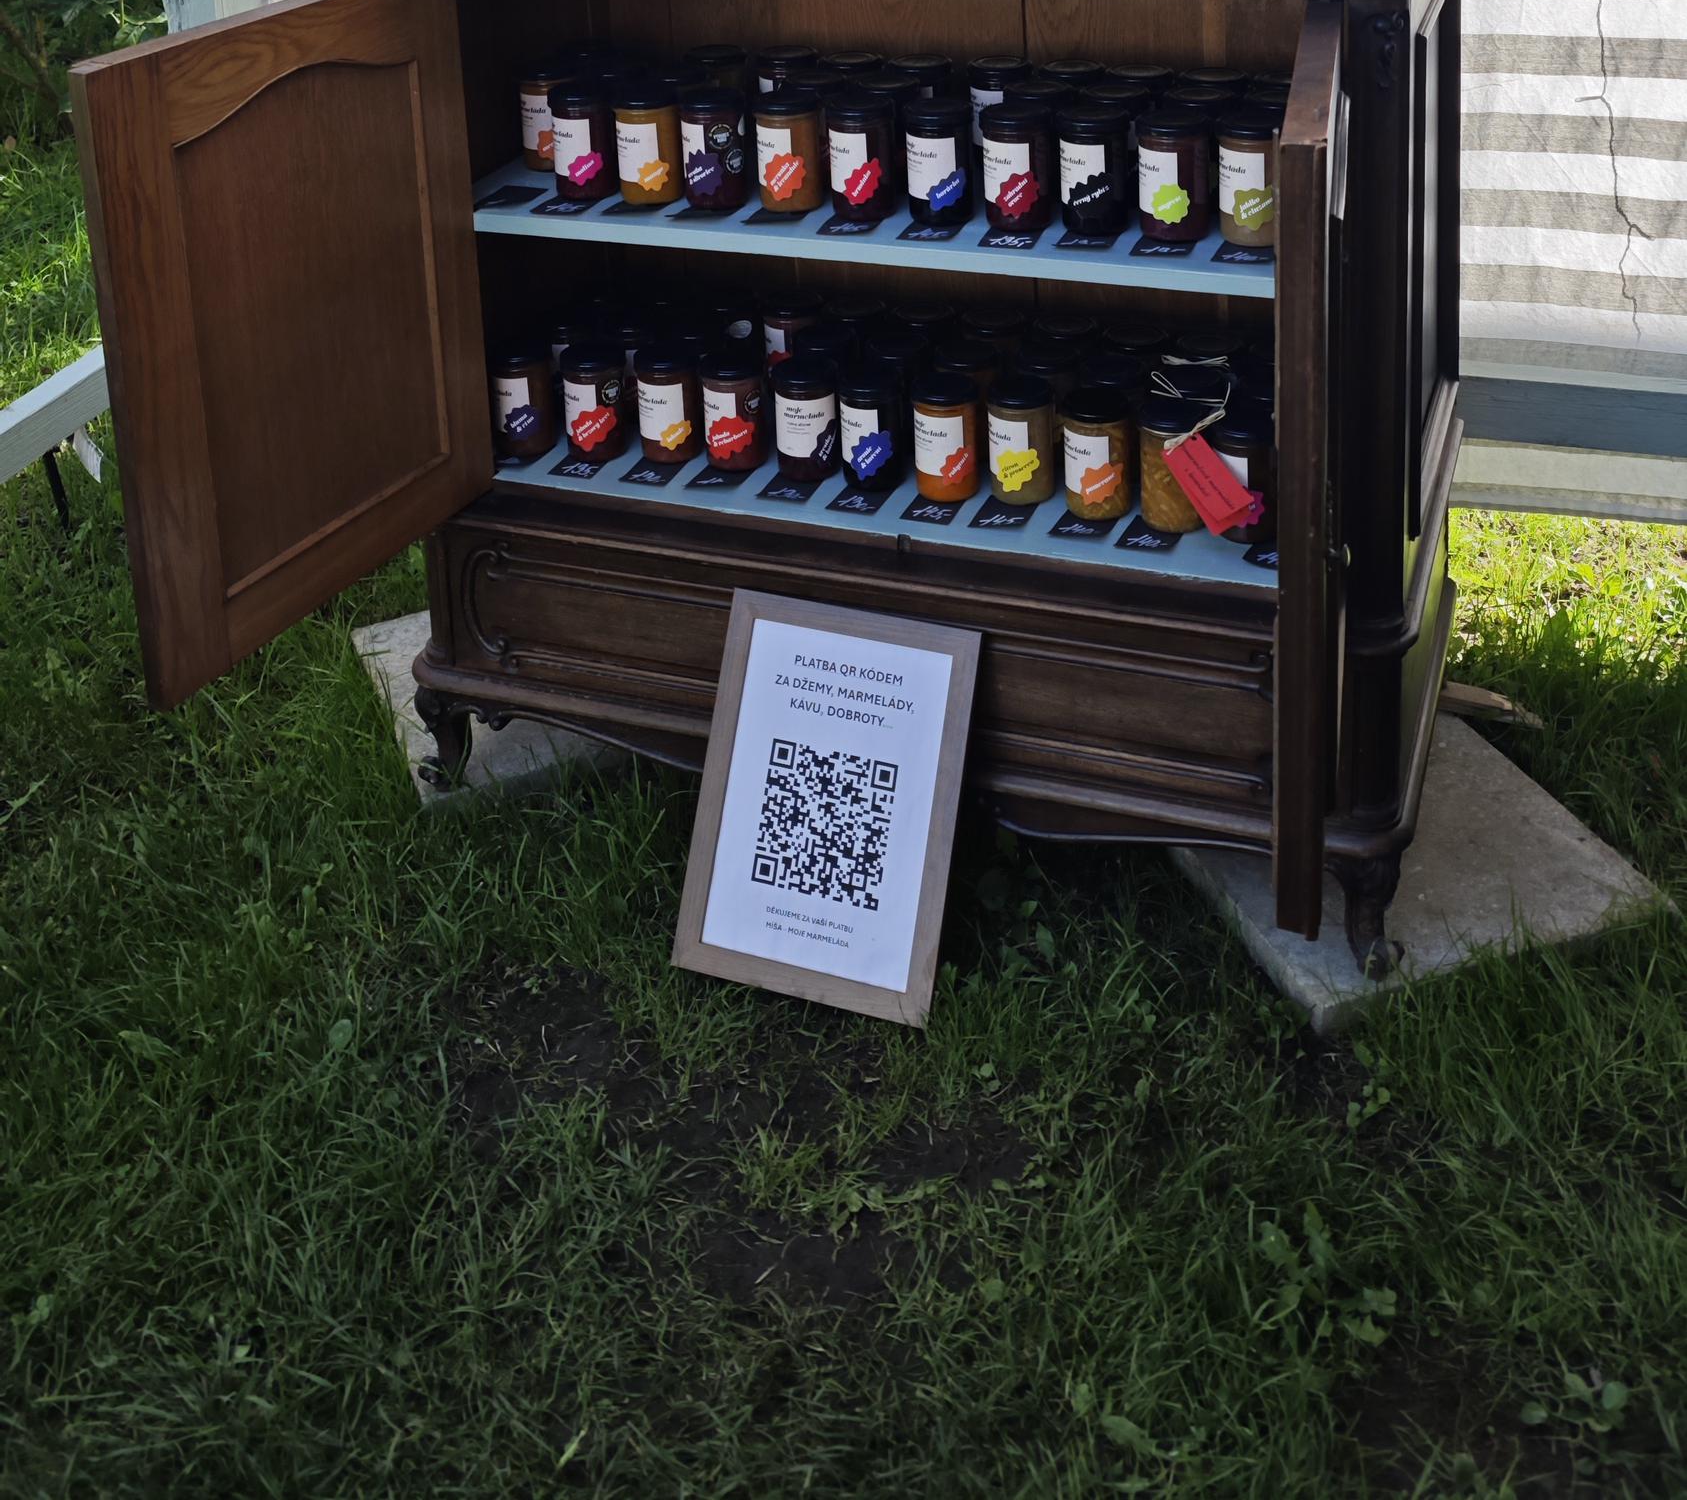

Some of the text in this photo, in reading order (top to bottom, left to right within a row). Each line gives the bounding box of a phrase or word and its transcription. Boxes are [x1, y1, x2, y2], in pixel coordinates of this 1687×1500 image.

[794, 654, 904, 686] PLATBA QR KÓDEM
[775, 674, 915, 715] ZA DŽEMY, MARMELÁDY,
[790, 697, 824, 716] KÁVU,
[766, 905, 801, 921] DĚKUJEME
[801, 914, 811, 923] ZA
[828, 921, 854, 934] PLATBU
[787, 926, 806, 938] MOJE
